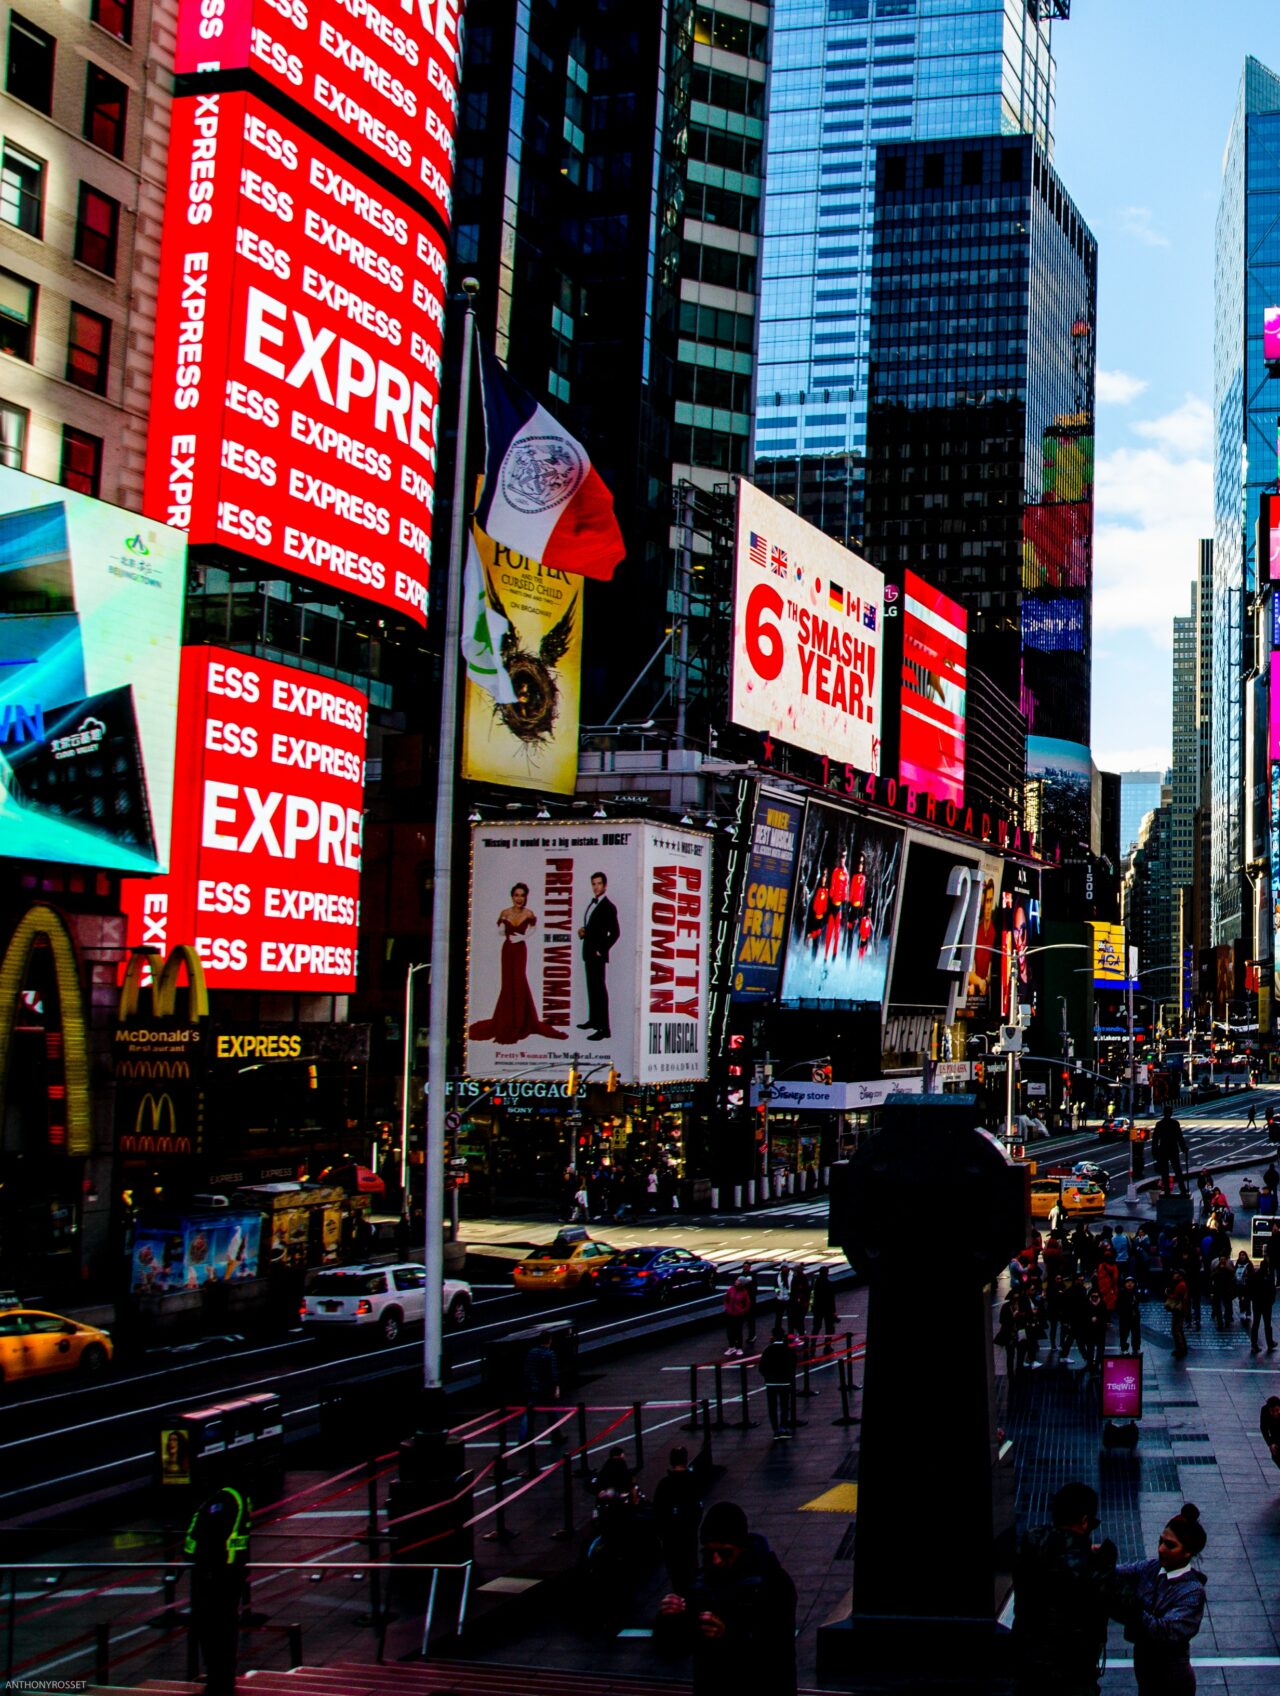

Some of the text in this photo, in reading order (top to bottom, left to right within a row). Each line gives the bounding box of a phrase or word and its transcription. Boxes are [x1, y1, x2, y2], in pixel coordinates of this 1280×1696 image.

[319, 20, 417, 117] EXPRESS
[314, 73, 412, 168] EXPRESS
[309, 157, 408, 245] EXPRESS
[304, 208, 404, 293] EXPRESS
[173, 252, 209, 410] EXPRESS
[302, 265, 402, 346] EXPRESS
[290, 410, 392, 482] EXPRESS
[289, 467, 390, 536] EXPRESS
[284, 525, 385, 589] EXPRESS
[501, 573, 563, 600] CURSED CHILD
[798, 607, 865, 675] SMASH
[207, 661, 363, 733] ESS EXPRESS
[206, 718, 362, 784] ESS EXPRESS
[198, 879, 356, 926] ESS EXPRESS
[543, 858, 574, 935] PRETTY
[743, 909, 785, 938] FROM
[747, 883, 788, 913] COME
[195, 936, 352, 977] ESS EXPRESS
[650, 866, 677, 1013] WOMAN
[675, 866, 701, 1019] PRETTY
[738, 936, 782, 965] AWAY
[542, 945, 572, 1027] WOMAN
[115, 1030, 201, 1043] McDonald's
[217, 1035, 302, 1058] EXPRESS
[648, 1060, 699, 1072] ON BROADWAY
[649, 1023, 698, 1054] THE MUSICAL
[507, 1106, 533, 1115] SONY
[807, 1092, 830, 1100] store
